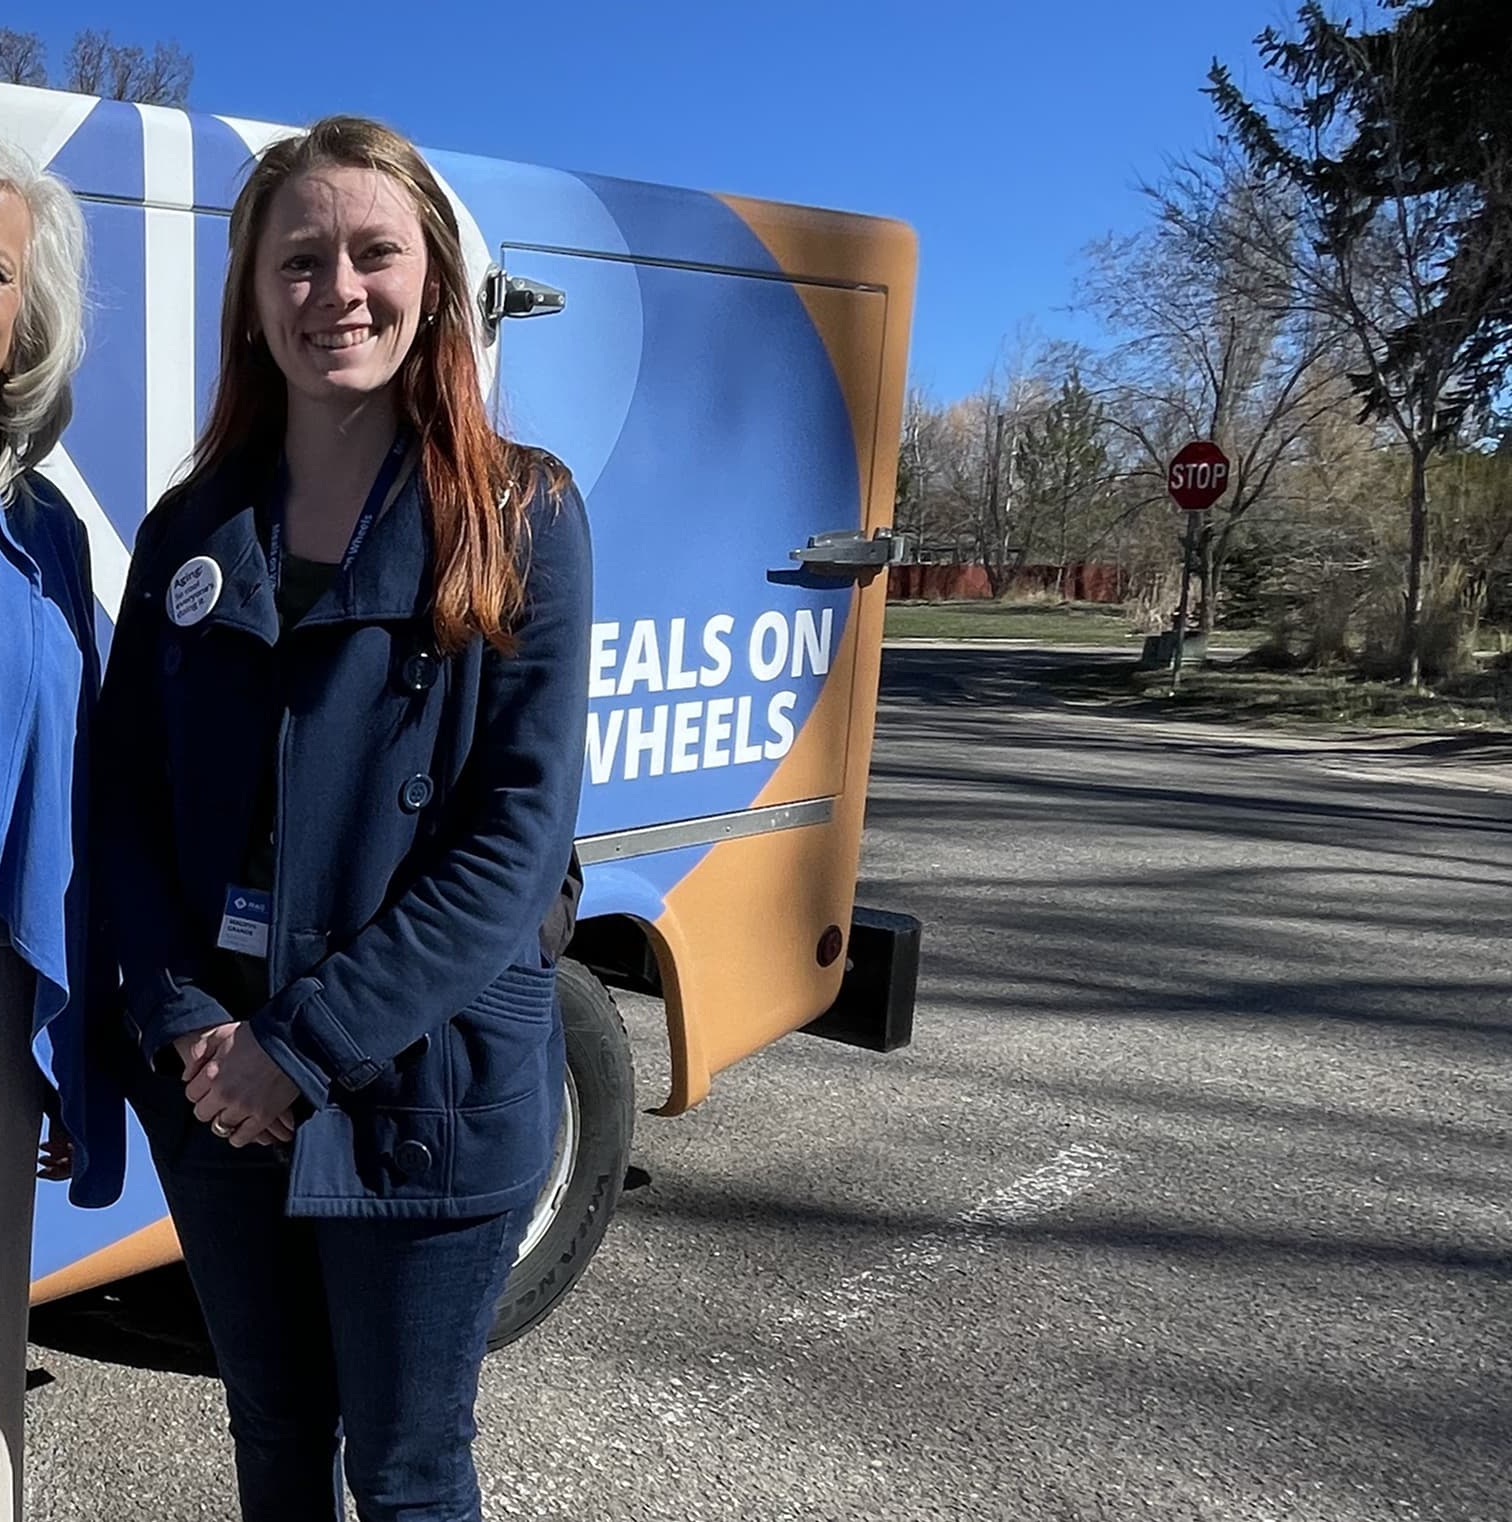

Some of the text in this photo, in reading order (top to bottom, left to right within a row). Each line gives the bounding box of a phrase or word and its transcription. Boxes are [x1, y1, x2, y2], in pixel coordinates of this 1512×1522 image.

[1170, 462, 1227, 490] STOP
[589, 607, 833, 699] EALS ON
